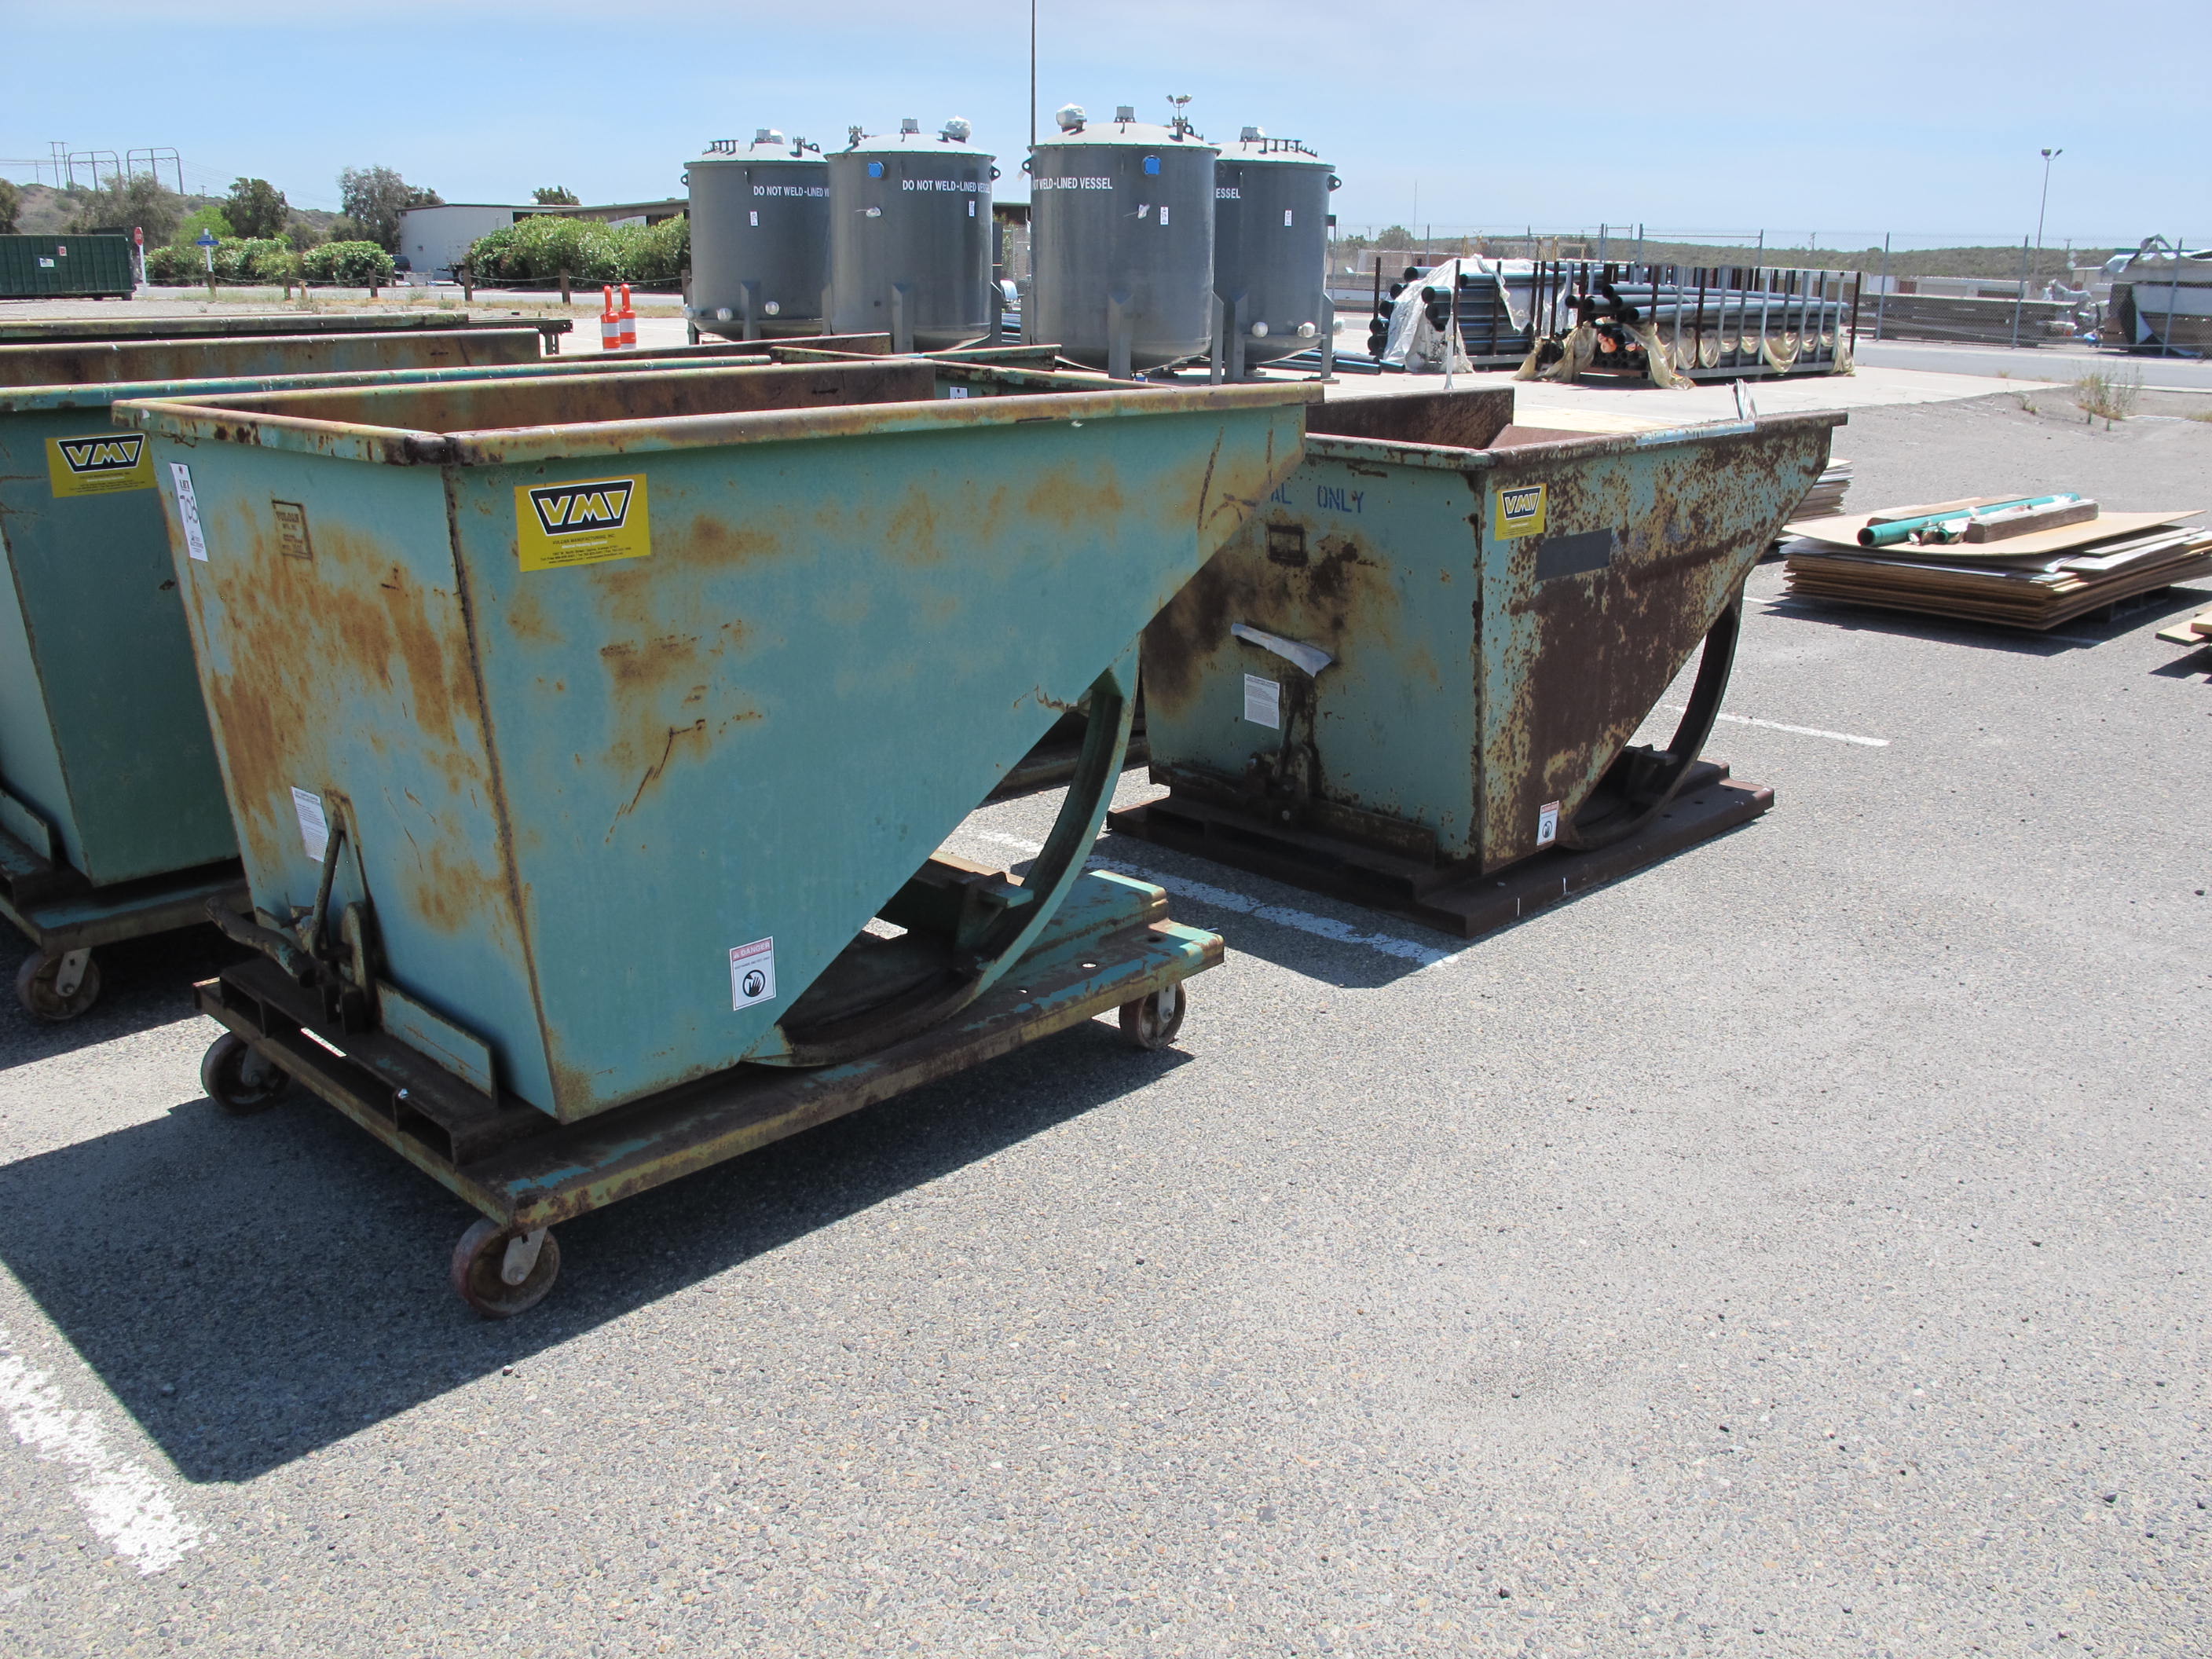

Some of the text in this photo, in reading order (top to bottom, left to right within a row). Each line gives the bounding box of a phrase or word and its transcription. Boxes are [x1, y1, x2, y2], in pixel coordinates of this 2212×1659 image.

[903, 180, 915, 191] DO
[917, 180, 933, 191] NOT
[1079, 177, 1113, 189] VESSEL
[753, 185, 765, 196] DO
[766, 186, 782, 196] NOT
[1215, 188, 1241, 199] ESSEL
[1271, 482, 1364, 513] AL ONLY
[741, 943, 771, 956] DANGER
